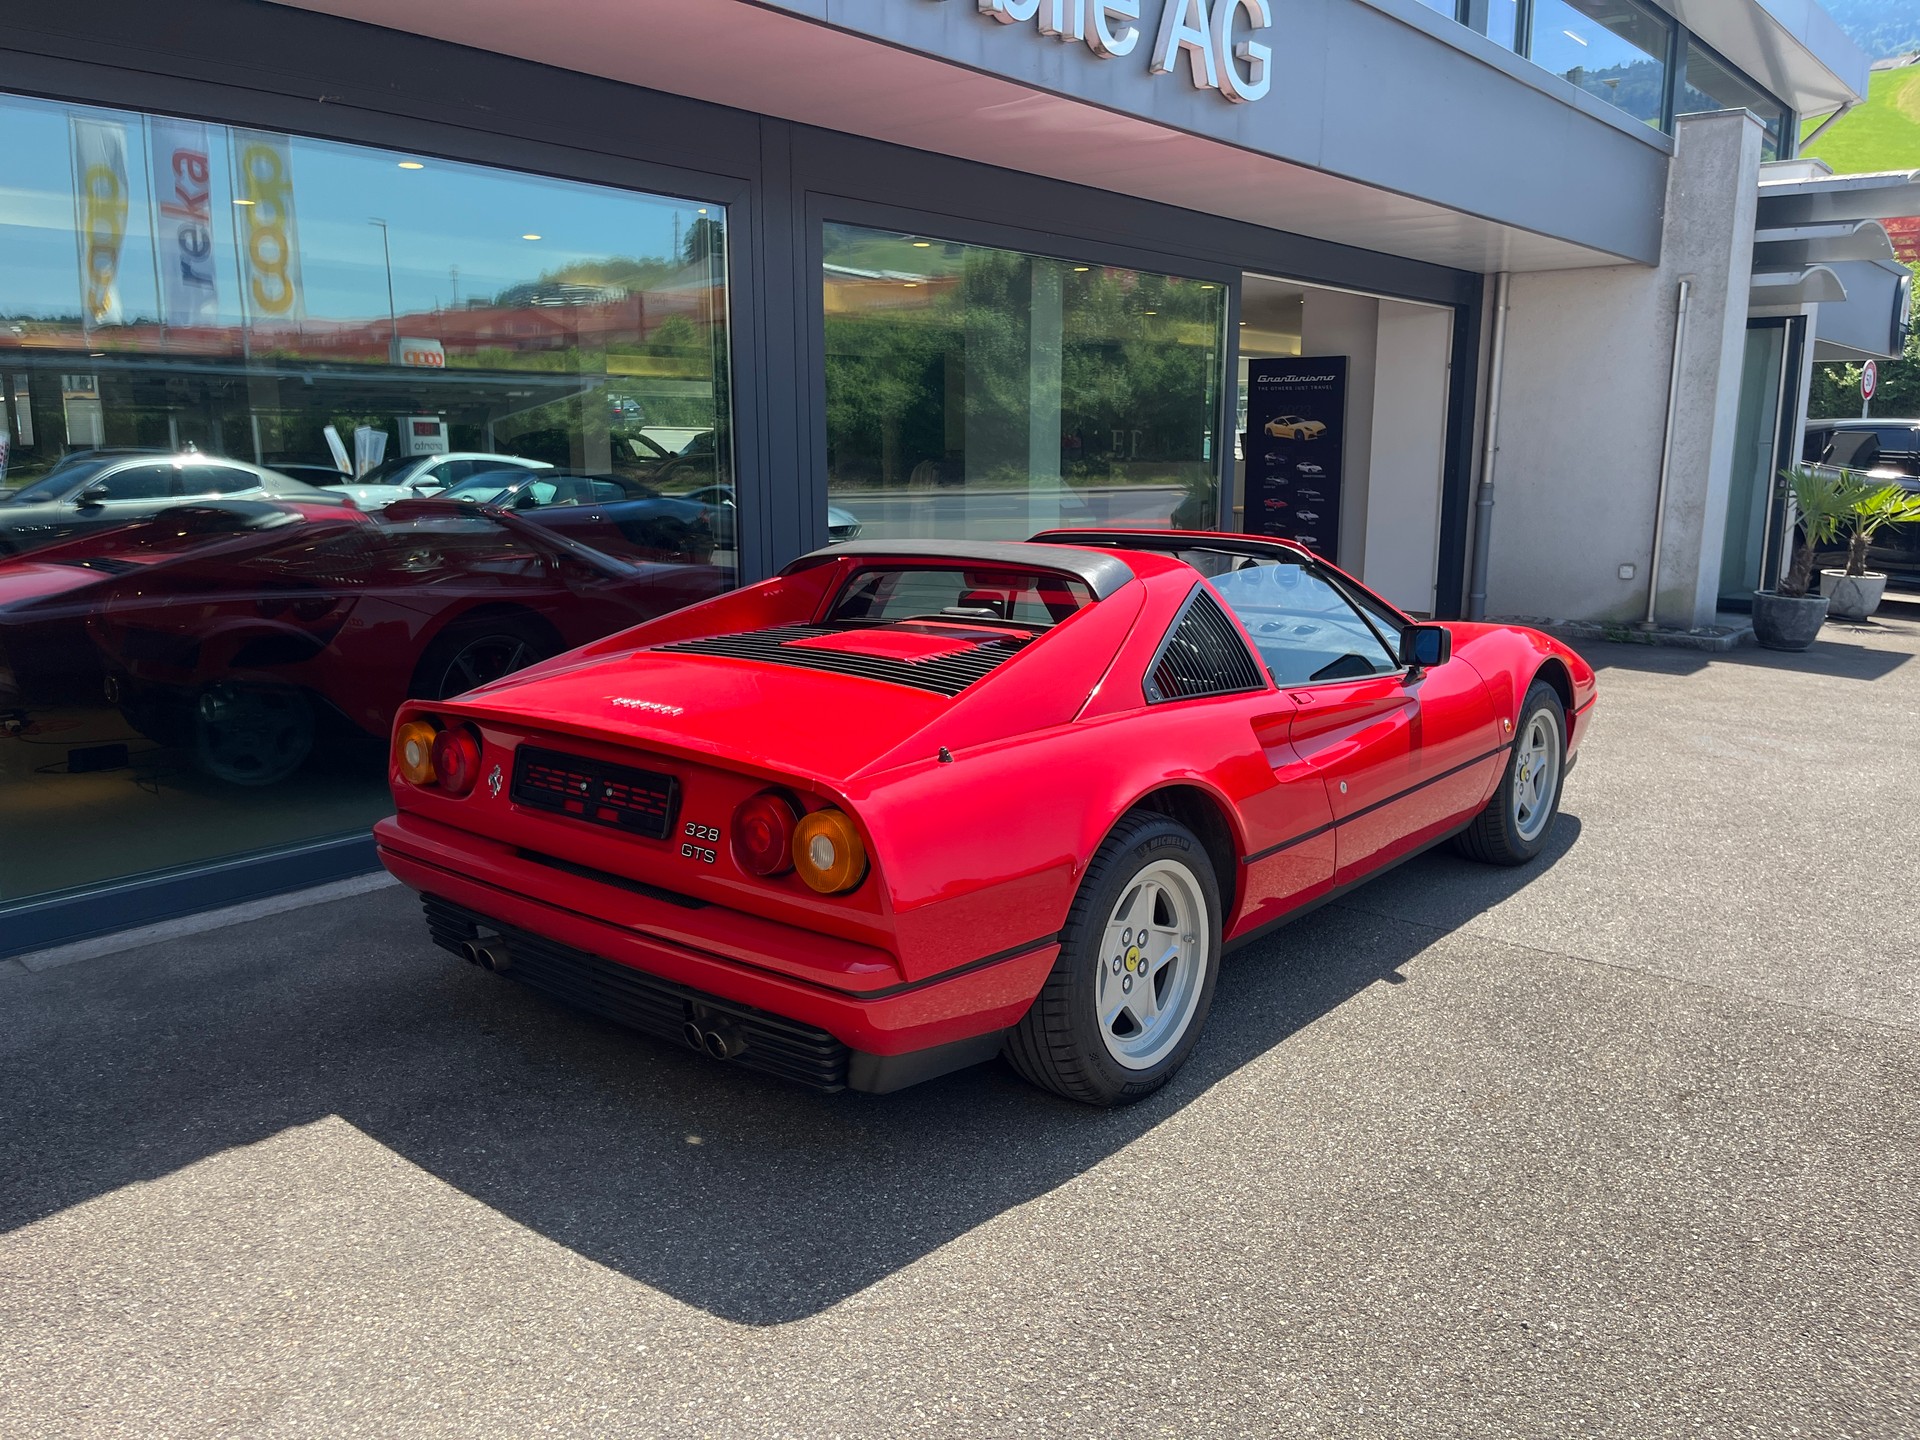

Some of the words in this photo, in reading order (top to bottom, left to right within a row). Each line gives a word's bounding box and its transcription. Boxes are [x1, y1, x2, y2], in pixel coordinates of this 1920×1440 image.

[1150, 0, 1271, 103] AG
[160, 148, 214, 291] reka
[243, 145, 294, 314] coop
[1257, 375, 1336, 383] GranTurismo
[685, 822, 719, 842] 328
[1150, 836, 1190, 849] MICHELIN
[681, 843, 716, 863] GTS
